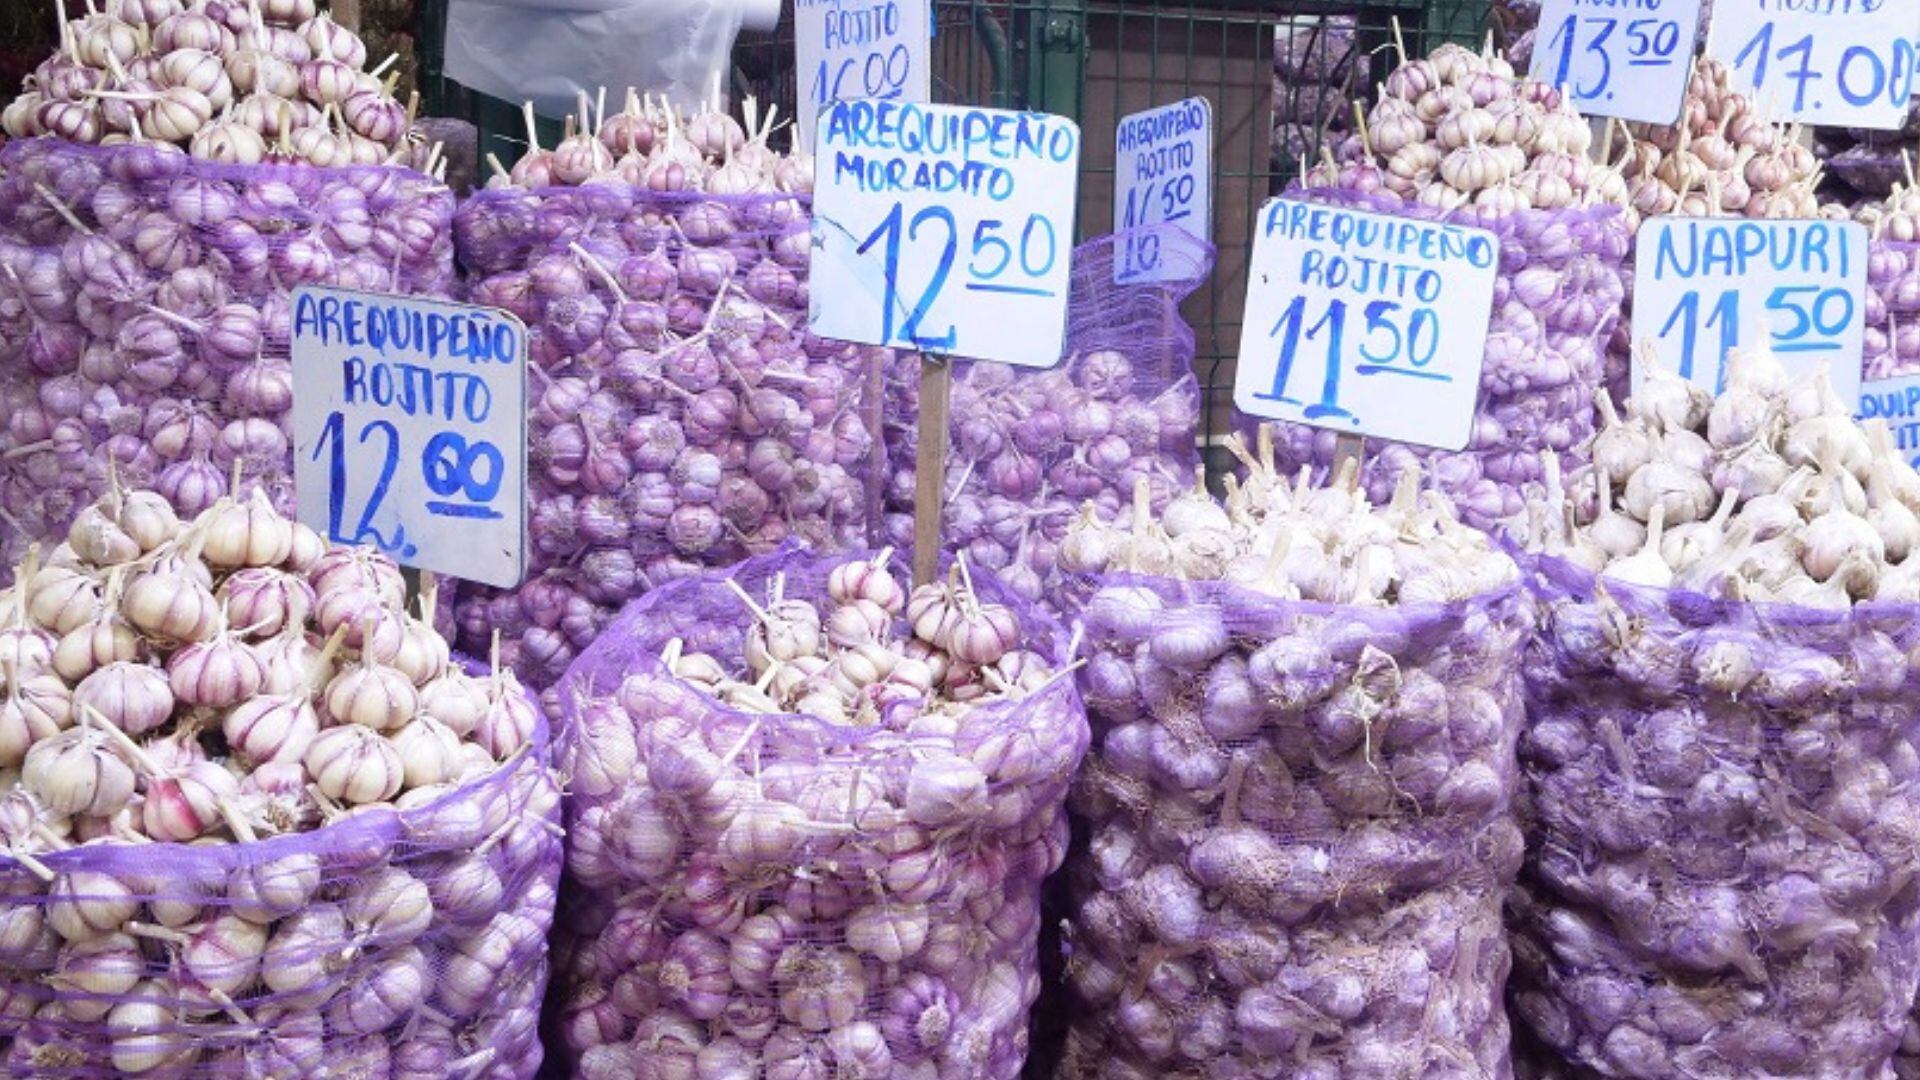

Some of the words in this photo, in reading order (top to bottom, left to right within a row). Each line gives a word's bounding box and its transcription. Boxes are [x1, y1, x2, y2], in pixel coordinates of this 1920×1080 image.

[827, 100, 1075, 163] AREQUIPEÑO
[1118, 101, 1203, 151] AREQUIPEÑO
[835, 150, 1014, 201] MORADITO
[1137, 140, 1194, 181] ROJITO
[1266, 200, 1493, 269] AREQUIPEÑO
[1655, 222, 1849, 280] NAPURI
[1300, 249, 1442, 302] ROJITO
[296, 293, 515, 364] AREQUIPEÑO
[343, 356, 491, 423] ROJITO
